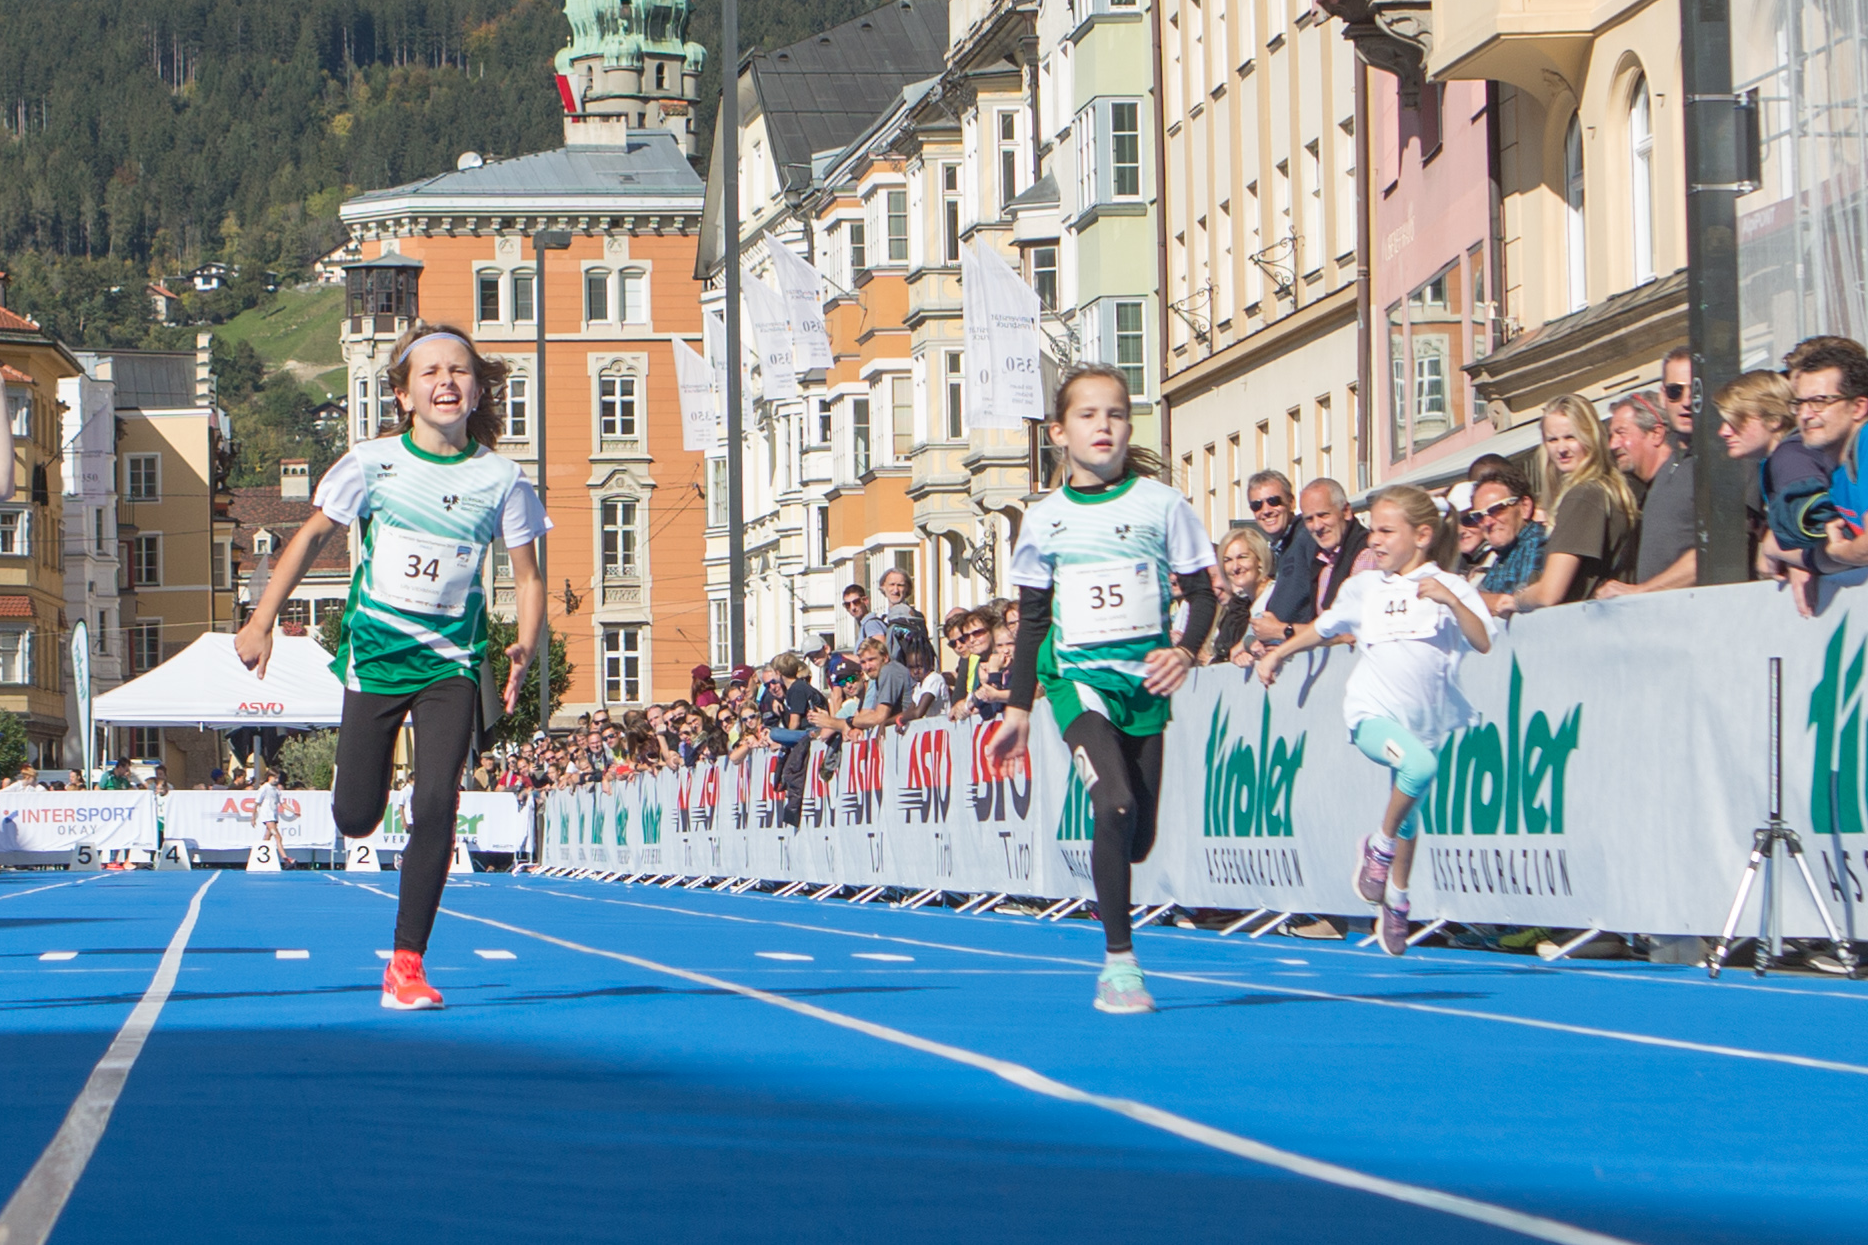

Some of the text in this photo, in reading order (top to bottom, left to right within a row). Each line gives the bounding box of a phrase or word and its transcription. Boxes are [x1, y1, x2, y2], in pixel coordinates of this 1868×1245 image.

[404, 554, 440, 582] 34
[1089, 583, 1124, 610] 35
[1384, 599, 1407, 616] 44
[1204, 689, 1307, 838] tiroler
[22, 806, 135, 823] INTERSPORT
[57, 824, 98, 836] OKAY
[77, 845, 92, 865] 5
[165, 845, 181, 863] 4
[257, 845, 271, 864] 3
[356, 845, 371, 864] 2
